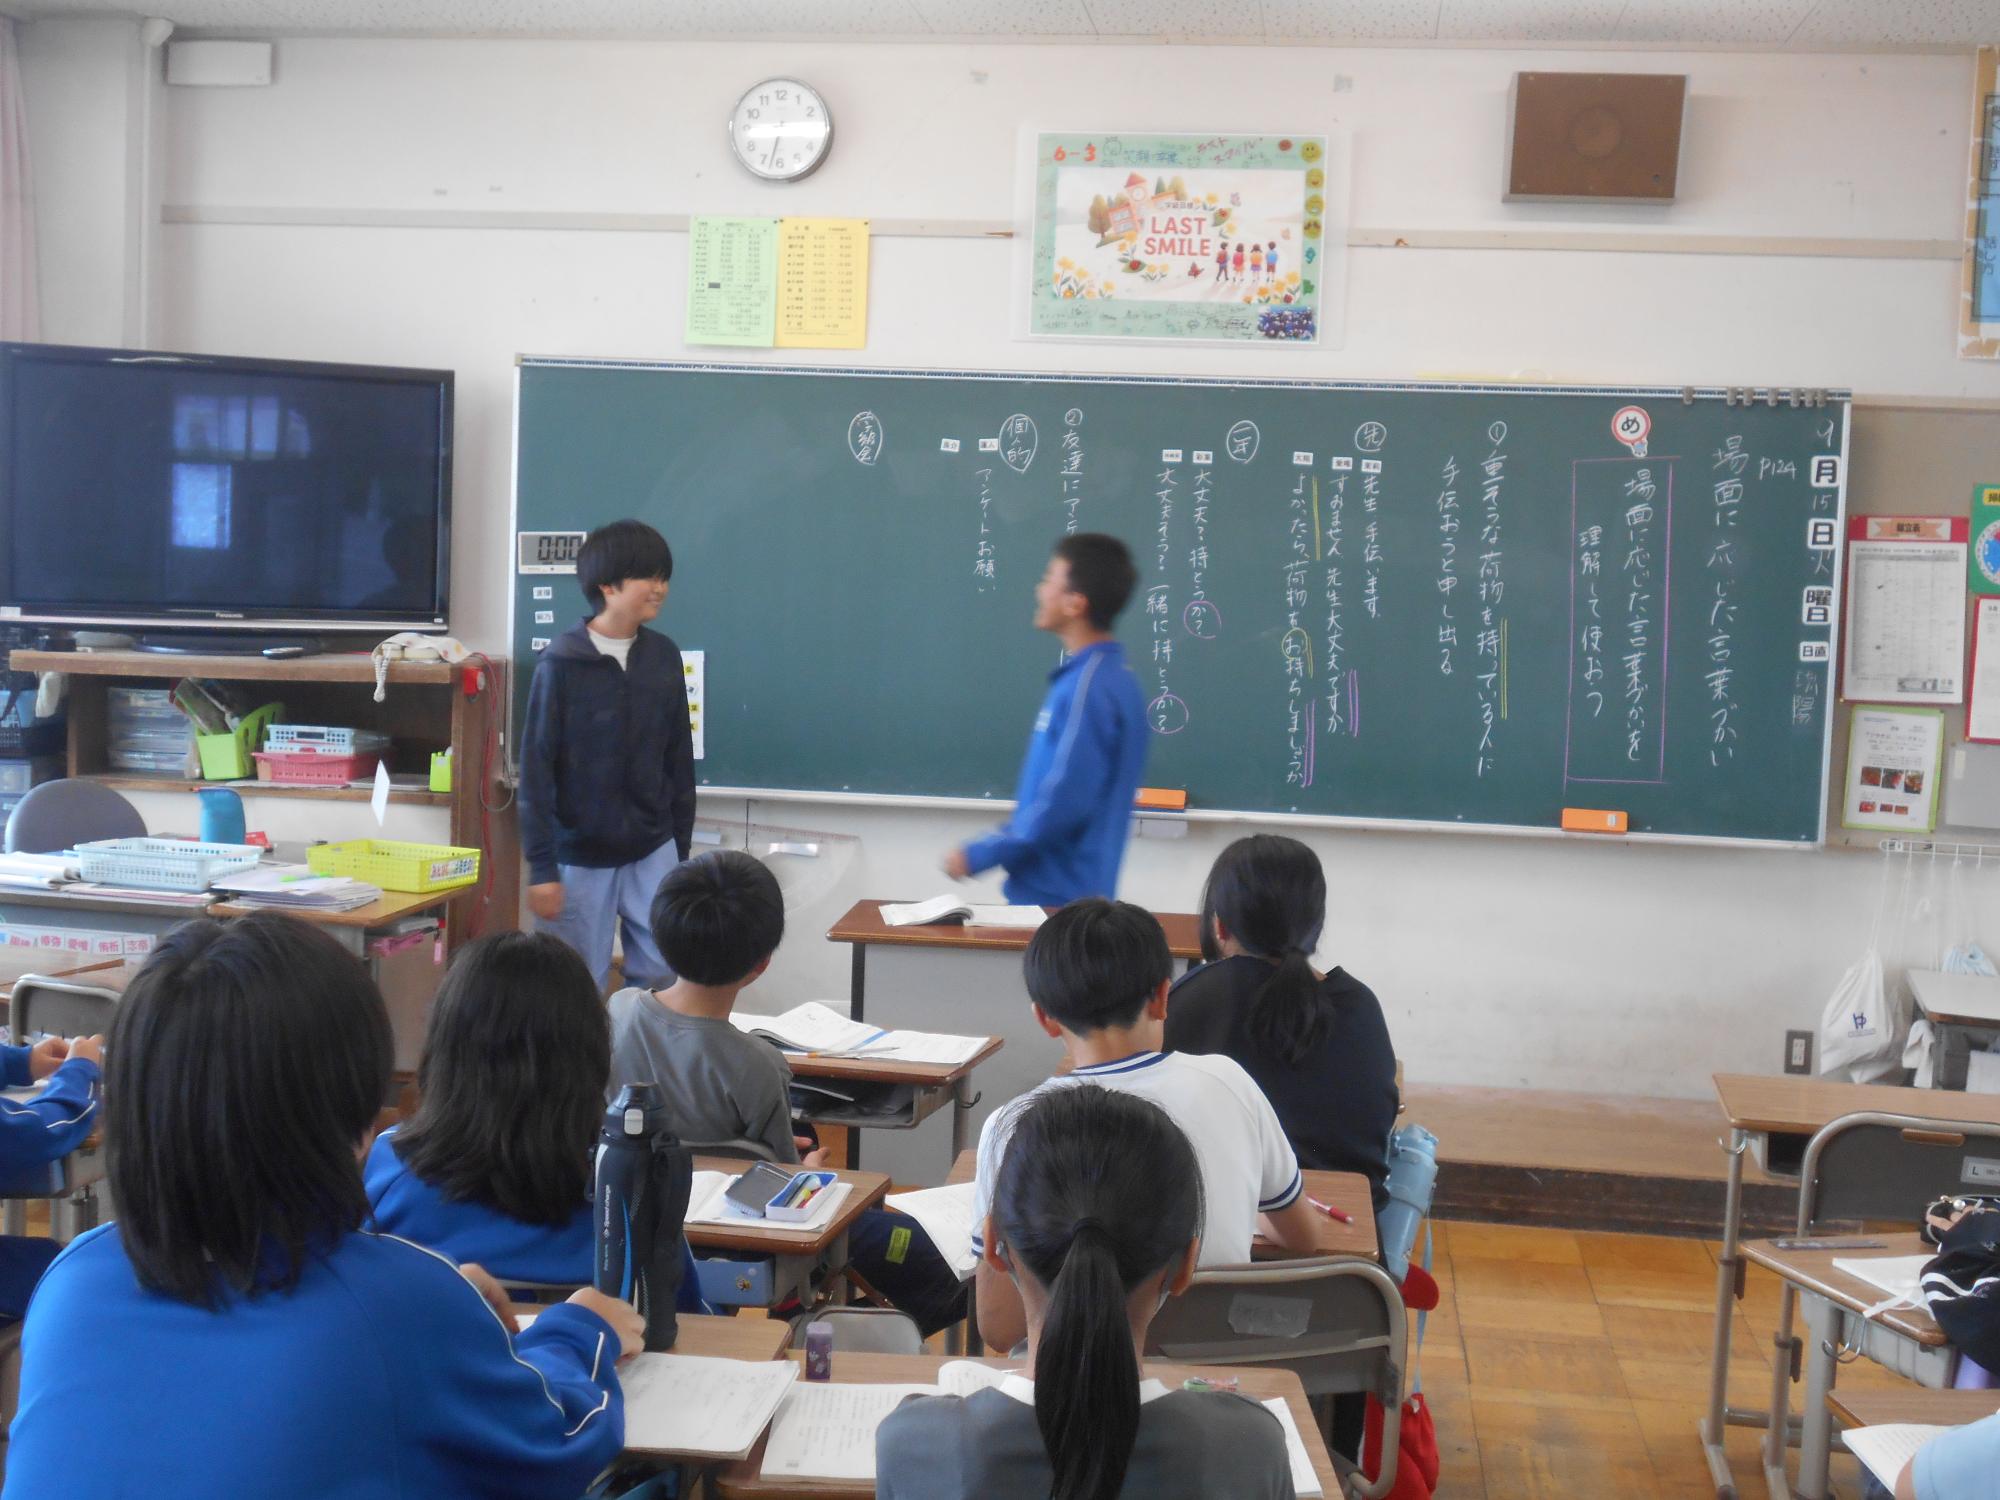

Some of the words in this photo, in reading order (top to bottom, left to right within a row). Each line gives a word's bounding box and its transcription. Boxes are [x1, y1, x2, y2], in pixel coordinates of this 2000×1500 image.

[760, 95, 769, 106] 11
[775, 89, 788, 101] 12
[796, 95, 801, 105] 1
[747, 108, 760, 120] 10
[806, 106, 815, 118] 2
[747, 141, 756, 152] 8
[806, 142, 814, 152] 4
[760, 154, 768, 165] 7
[775, 158, 785, 169] 6
[793, 154, 801, 165] 5
[1151, 216, 1207, 235] LAST
[1144, 237, 1211, 257] SMILE
[1622, 416, 1641, 434] め
[1007, 416, 1031, 465] 個人的
[538, 536, 582, 561] 0:00
[1437, 456, 1461, 675] 手伝おうと申し出る
[1705, 434, 1749, 768] 場面に応じた言葉づかい
[1623, 469, 1657, 761] 場面に応じた言葉づかいを
[1579, 526, 1603, 718] 理解して使おう
[1802, 645, 1828, 659] 日直
